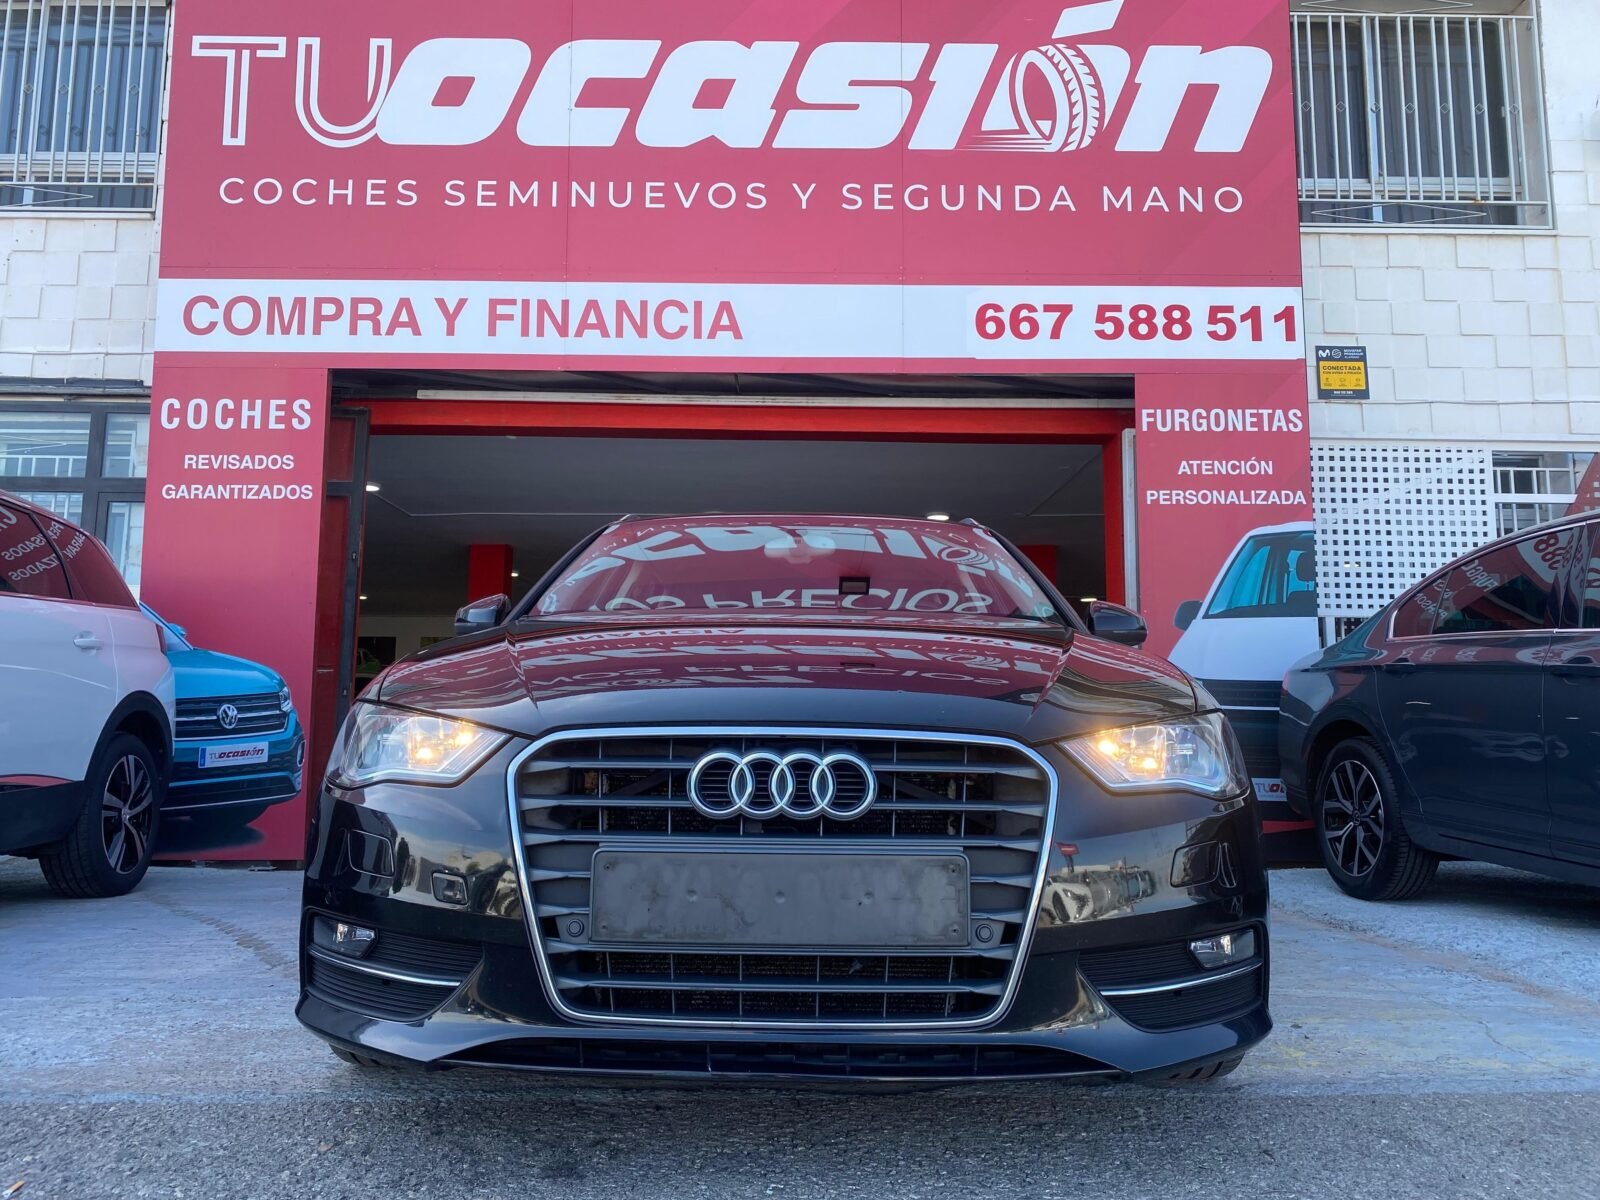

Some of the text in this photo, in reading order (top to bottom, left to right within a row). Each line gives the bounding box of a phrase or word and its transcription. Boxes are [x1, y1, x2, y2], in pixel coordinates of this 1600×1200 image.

[219, 177, 1243, 213] COCHES SEMINUEVOS Y SEGUNDA MANO
[183, 295, 743, 341] COMPRA Y FINANCIA
[975, 303, 1296, 342] 667 588 511
[160, 398, 312, 430] COCHES
[1141, 408, 1303, 433] FURGONETAS
[184, 454, 295, 470] REVISADOS
[1177, 456, 1273, 475] ATENCIÓN
[161, 484, 313, 500] GARANTIZADOS
[1146, 489, 1307, 505] PERSONALIZADA
